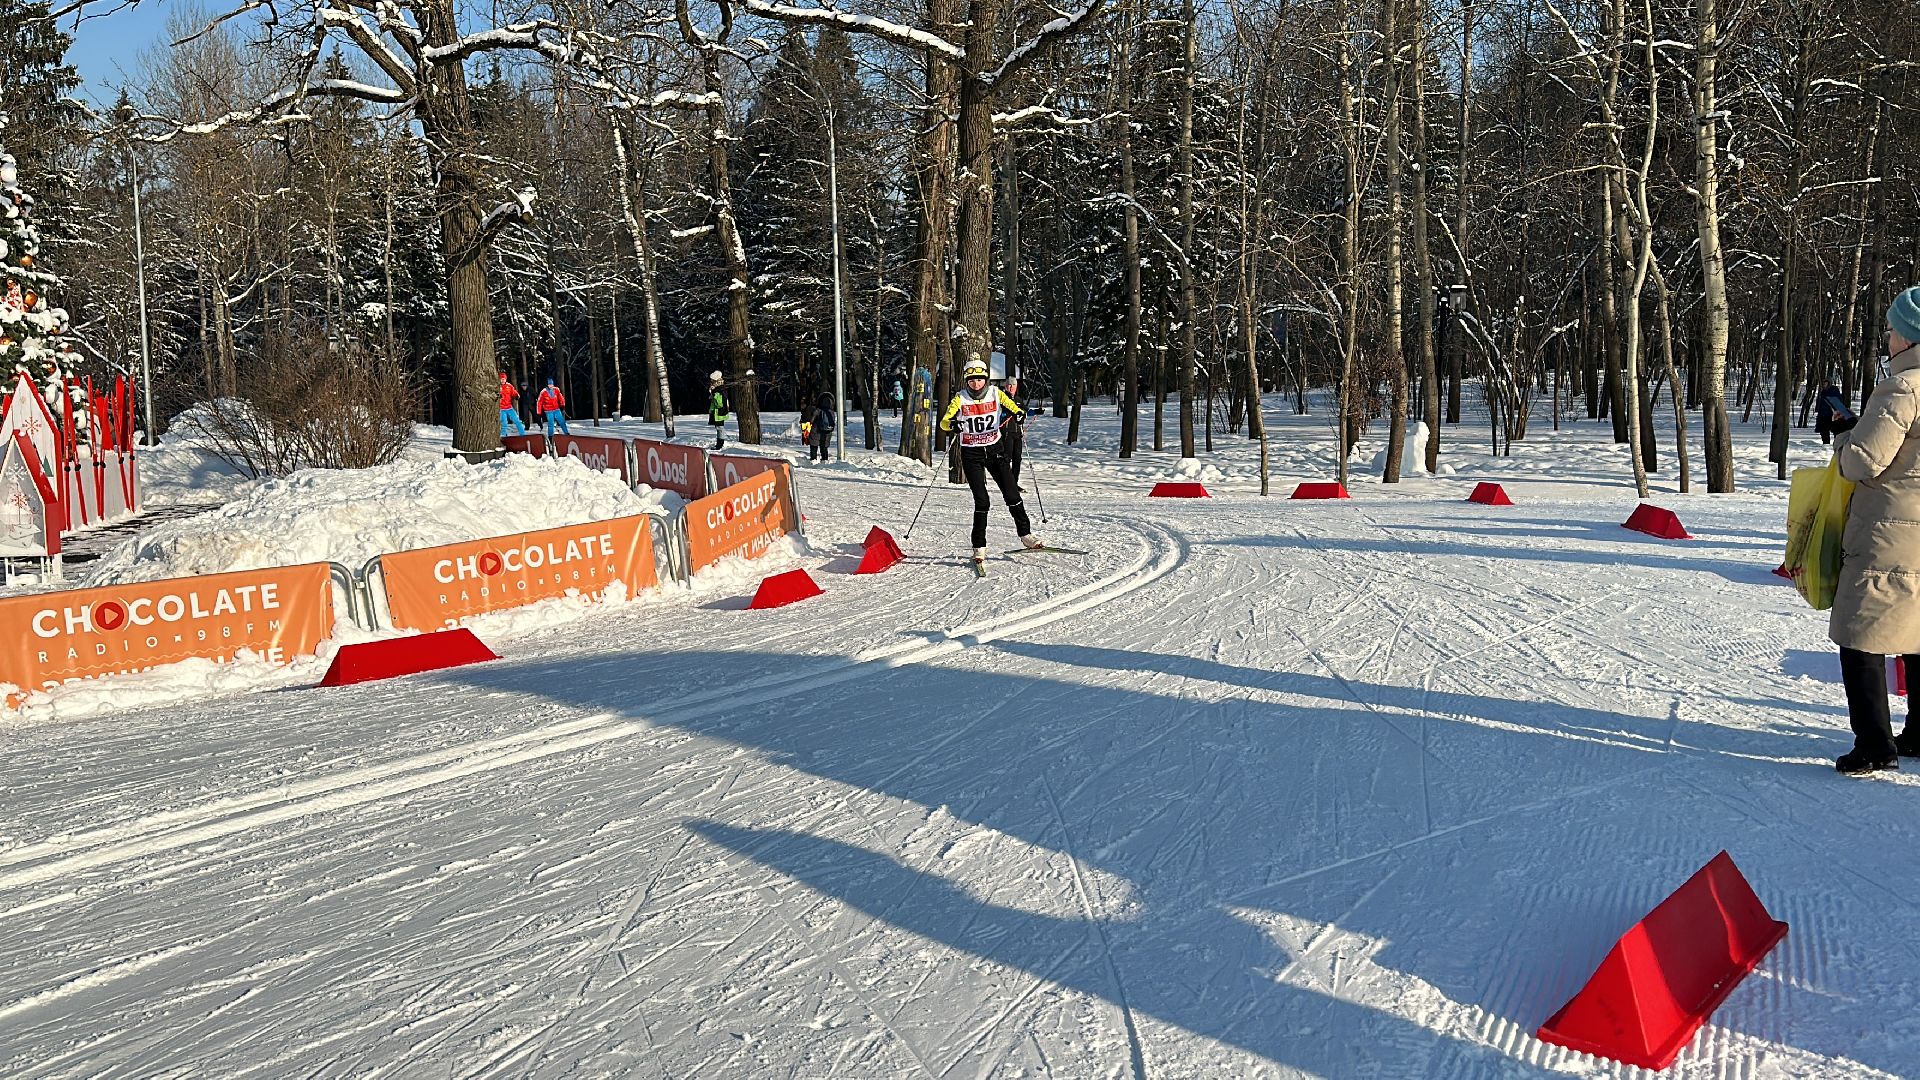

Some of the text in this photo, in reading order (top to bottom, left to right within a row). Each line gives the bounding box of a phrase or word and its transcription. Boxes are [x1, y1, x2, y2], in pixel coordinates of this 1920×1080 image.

[966, 415, 994, 433] 162
[709, 523, 744, 549] RADIO
[434, 534, 615, 584] CHOCOLATE
[440, 581, 526, 605] RADIO
[31, 583, 280, 638] CHOCOLATE
[37, 636, 159, 663] RADIO
